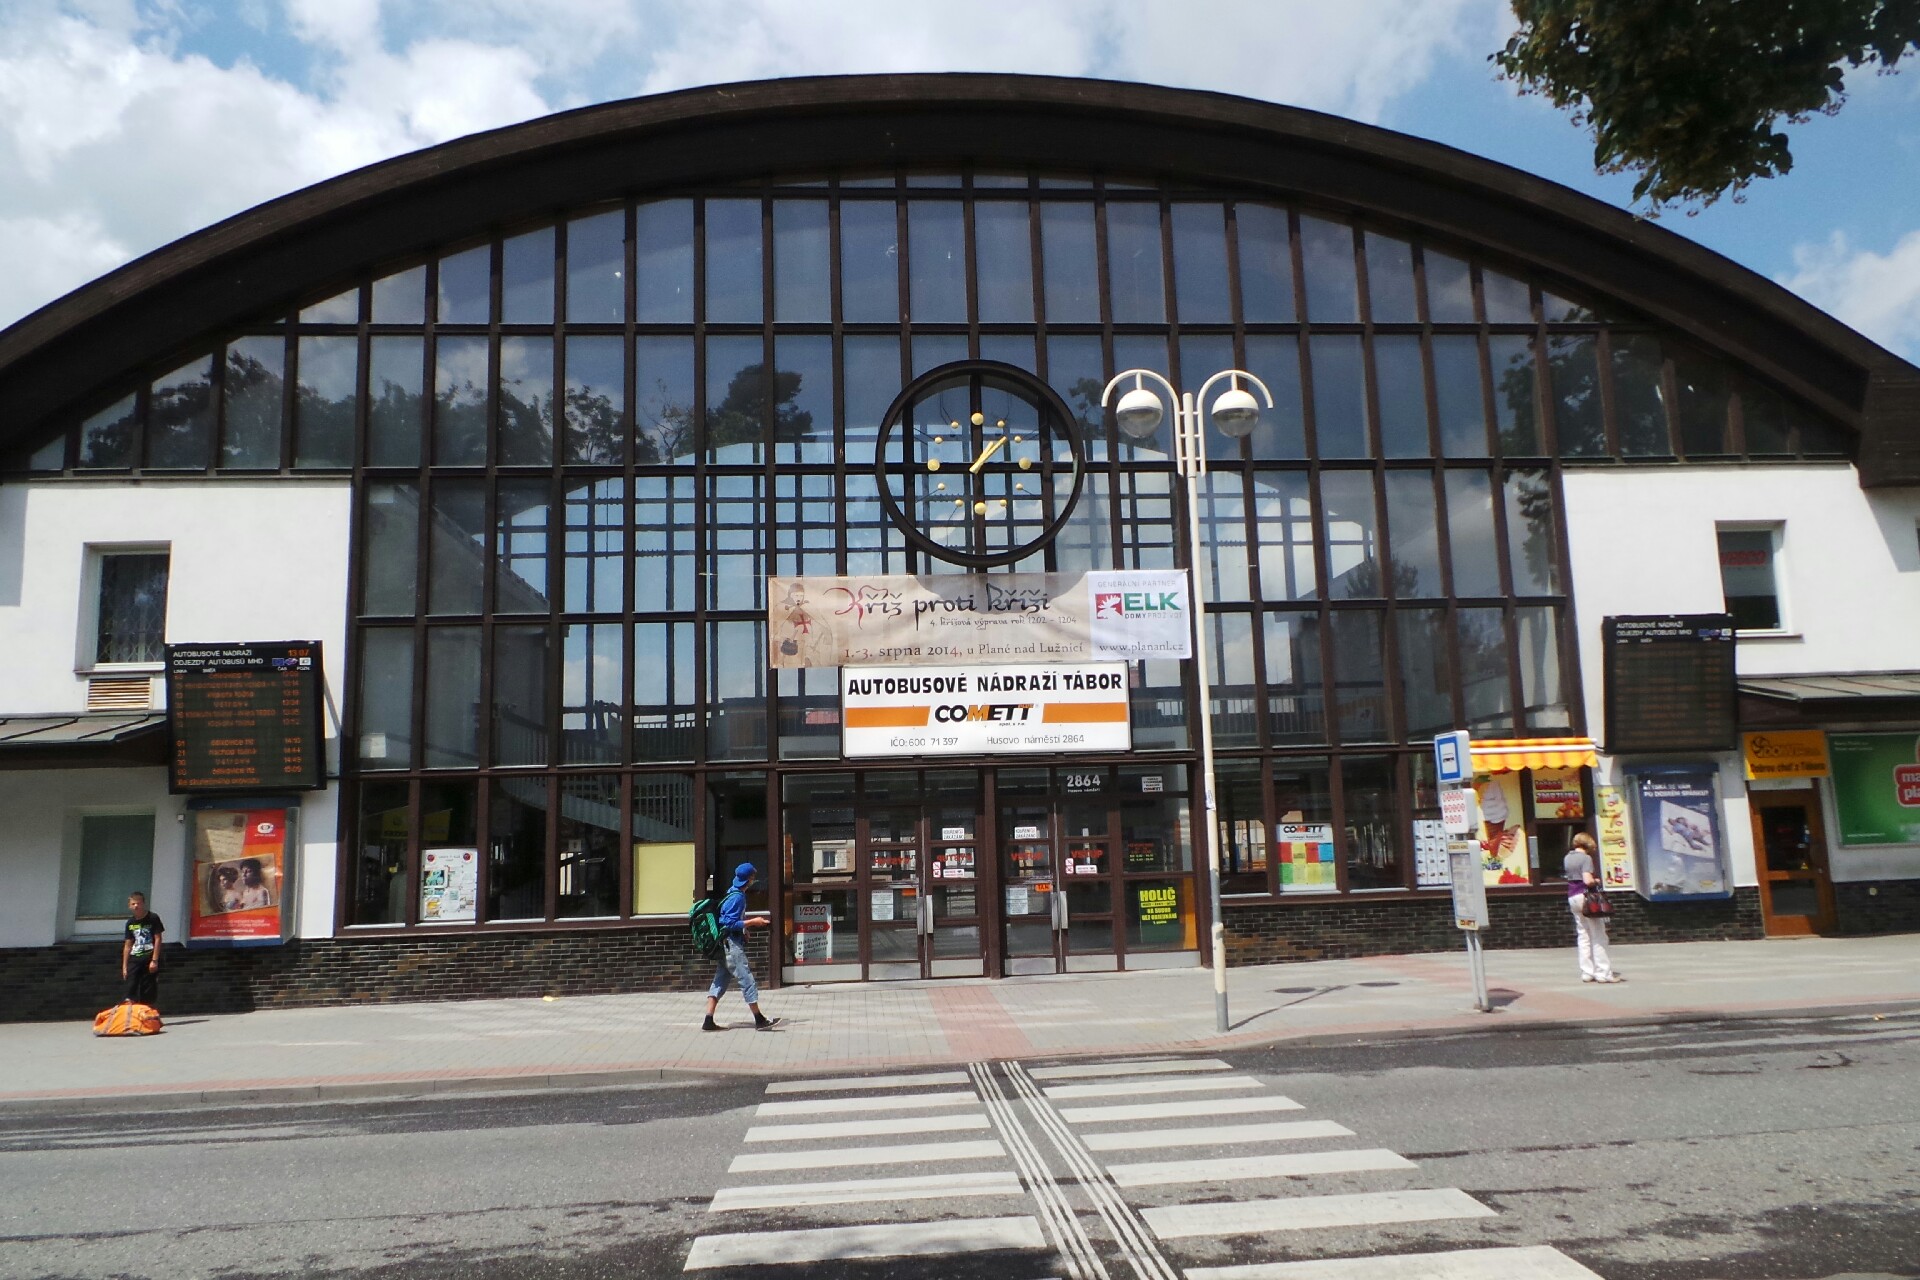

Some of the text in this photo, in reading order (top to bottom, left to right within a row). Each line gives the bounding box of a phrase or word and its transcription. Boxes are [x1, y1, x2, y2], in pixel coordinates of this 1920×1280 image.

[1098, 580, 1139, 588] GENERÁLNÍ
[912, 594, 977, 631] proti
[985, 583, 1051, 617] kříži
[1123, 592, 1182, 611] ELK
[974, 617, 1008, 631] výprava
[1028, 616, 1046, 624] 1202
[1059, 616, 1077, 624] 1204
[173, 649, 253, 658] AUTOBUSOVÉ NÁDRAŽÍ
[879, 647, 921, 660] srpna
[967, 646, 974, 654] u
[979, 643, 1010, 655] Plané
[1014, 643, 1035, 654] nad
[1040, 642, 1083, 653] Lužnicí
[1099, 641, 1184, 654] www.plananl.cz
[208, 657, 245, 665] AUTOBUSŮ
[848, 670, 1122, 695] AUTOBUSOVÉ NÁDRAŽÍ TÁBOR
[935, 704, 1034, 723] COMETT
[931, 737, 940, 746] 71
[943, 737, 958, 746] 397
[987, 734, 1084, 745] Husovo náměstí 2864
[1067, 774, 1101, 787] 2864
[1071, 849, 1103, 859] VSTUP
[1140, 886, 1176, 901] HOLIČ
